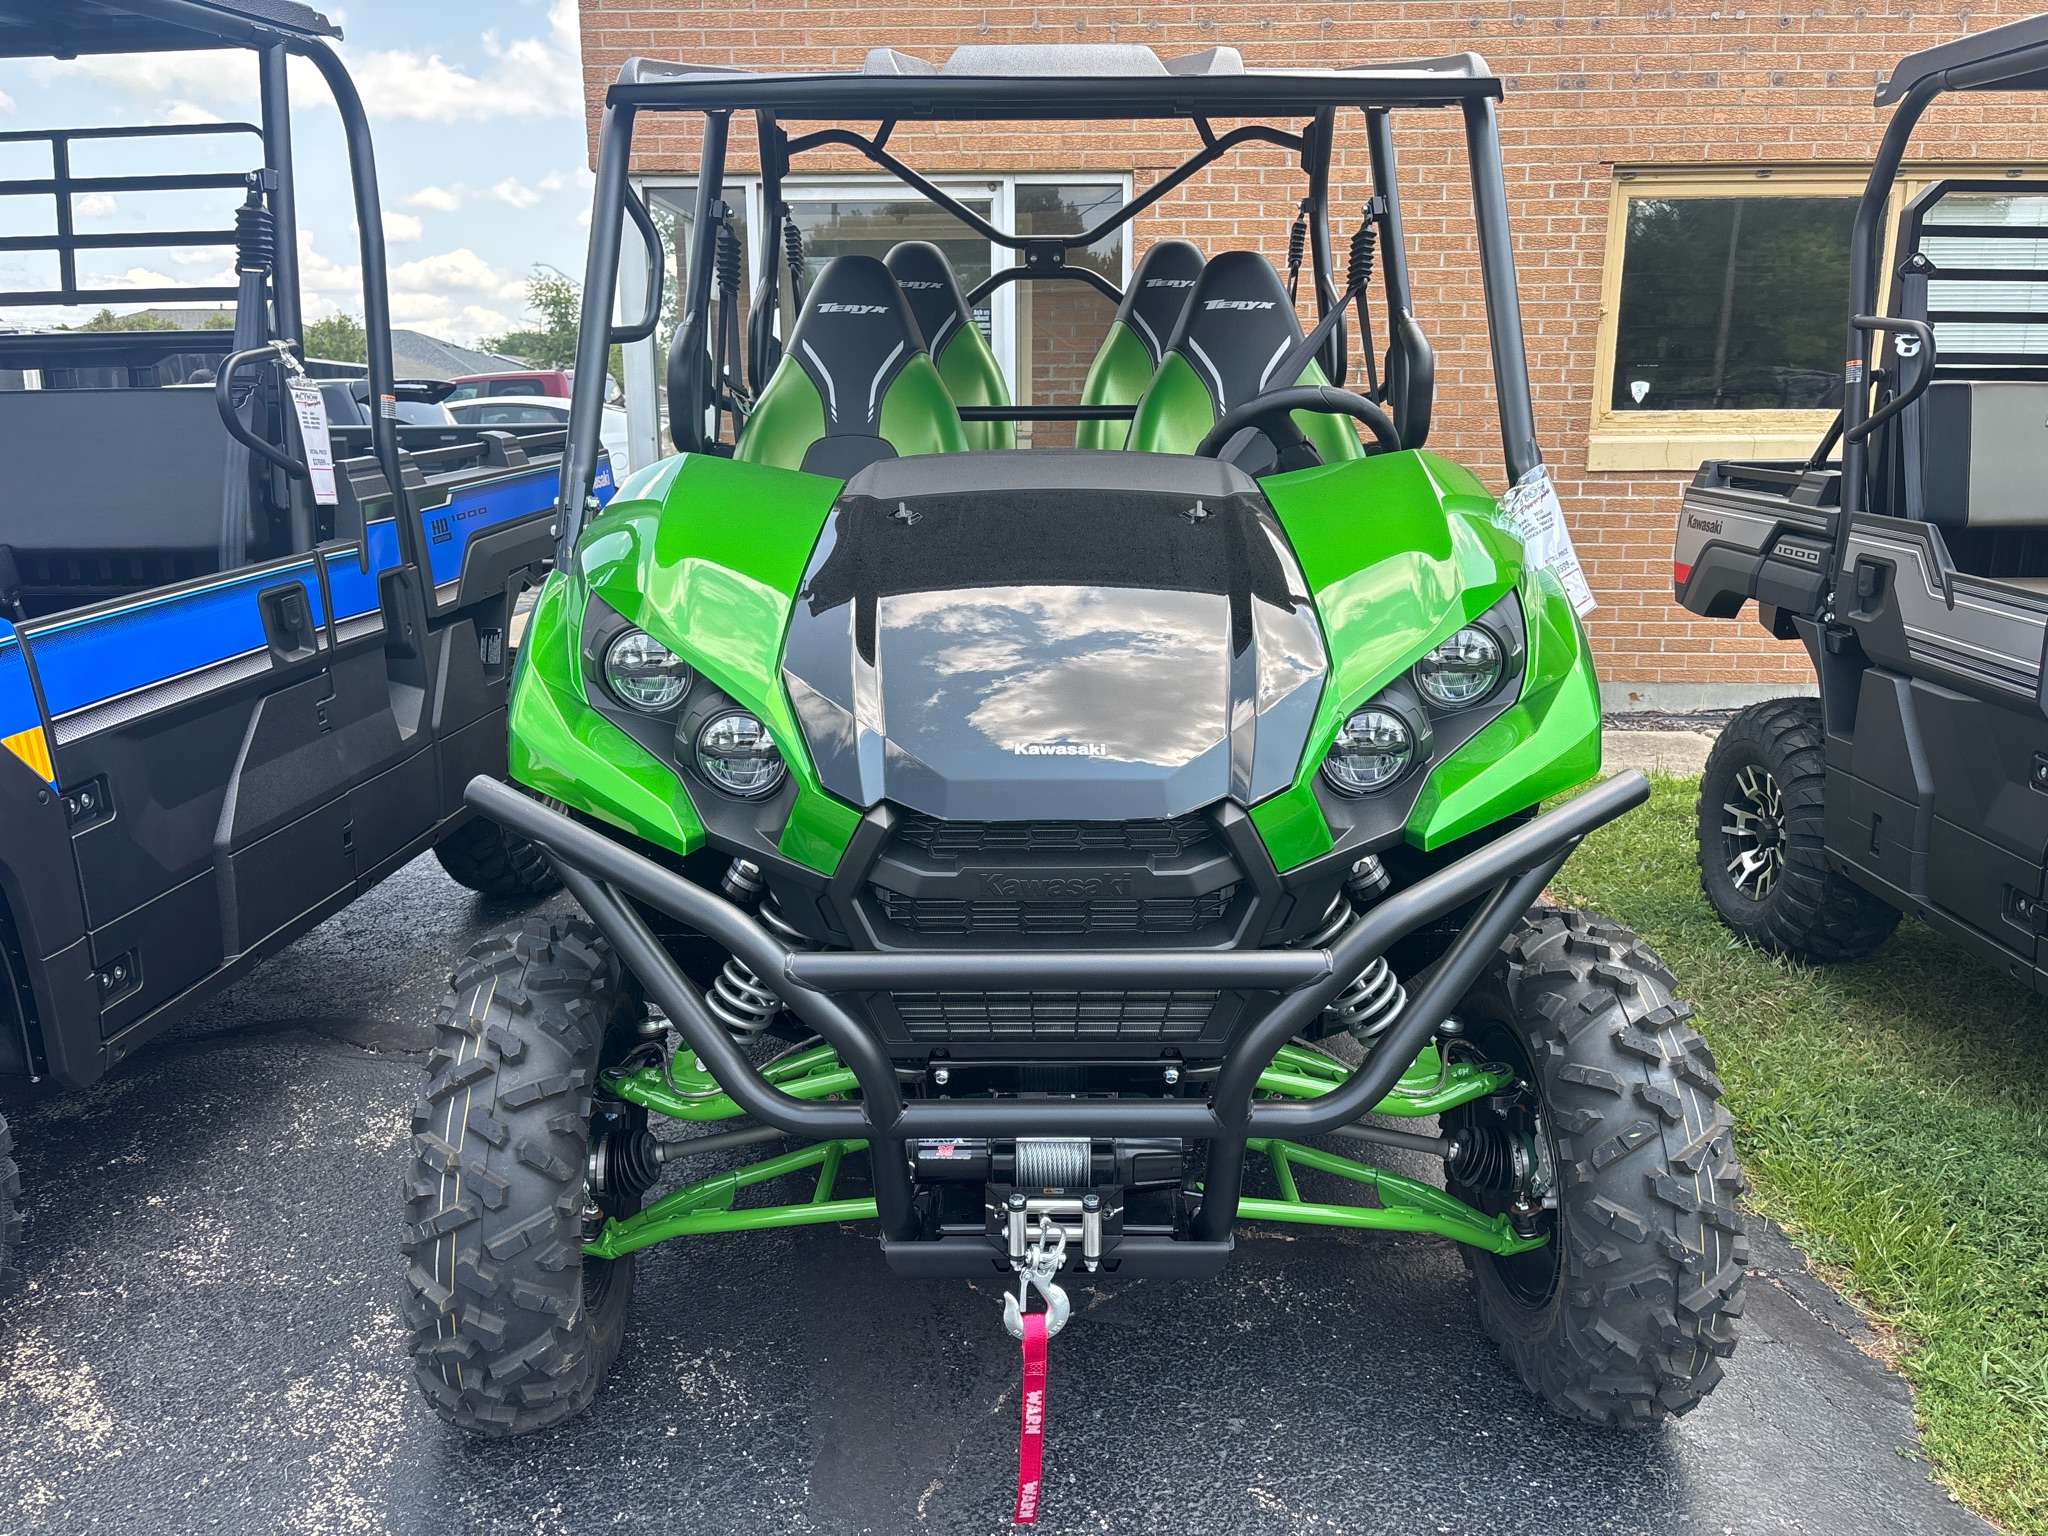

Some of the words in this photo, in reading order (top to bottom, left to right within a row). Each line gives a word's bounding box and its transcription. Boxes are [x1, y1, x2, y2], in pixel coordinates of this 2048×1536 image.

[451, 506, 487, 523] 1000
[431, 517, 449, 535] HD
[1687, 514, 1723, 535] Kawasaki
[1778, 546, 1818, 561] 1000
[1014, 743, 1106, 755] Kawasaki
[979, 872, 1132, 897] Kawasaki
[1025, 1390, 1043, 1434] WARN
[1018, 1480, 1039, 1518] WARN
